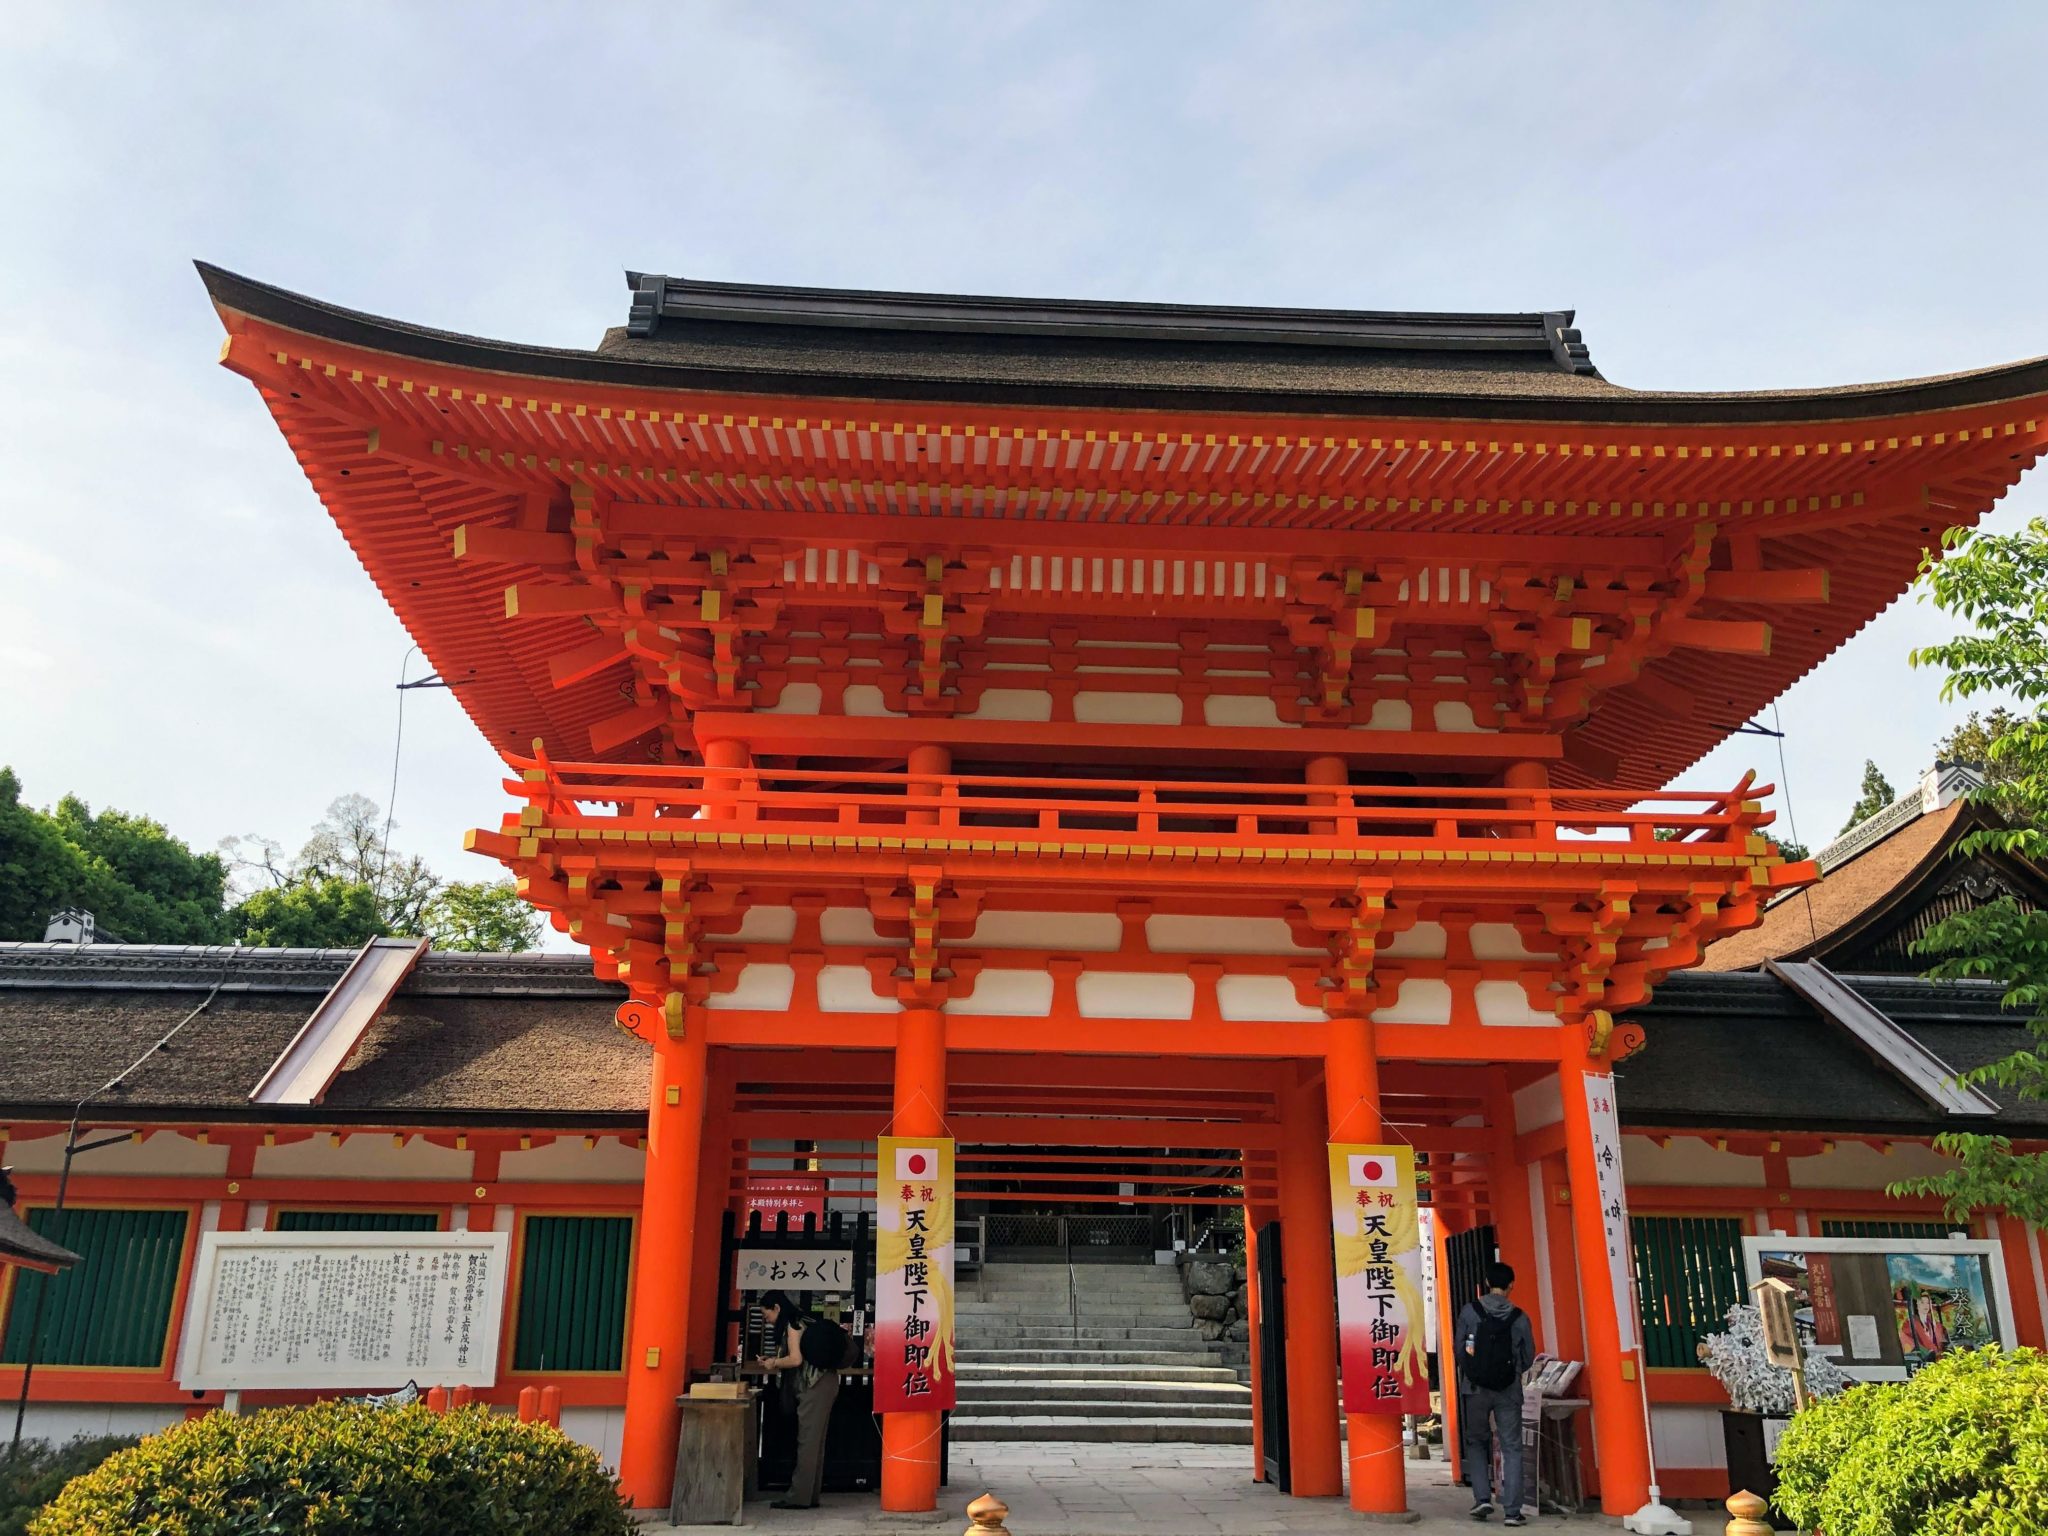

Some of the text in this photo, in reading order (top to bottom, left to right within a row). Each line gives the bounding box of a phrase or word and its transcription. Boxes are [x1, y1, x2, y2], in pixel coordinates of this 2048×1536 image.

[900, 1183, 935, 1202] 奉祝
[1356, 1190, 1396, 1208] 奉祝
[769, 1257, 847, 1283] おみくじ
[902, 1208, 931, 1398] 天皇陛下御即位
[1363, 1215, 1403, 1400] 天皇陛下御即位
[1949, 1287, 1974, 1337] 葵祭
